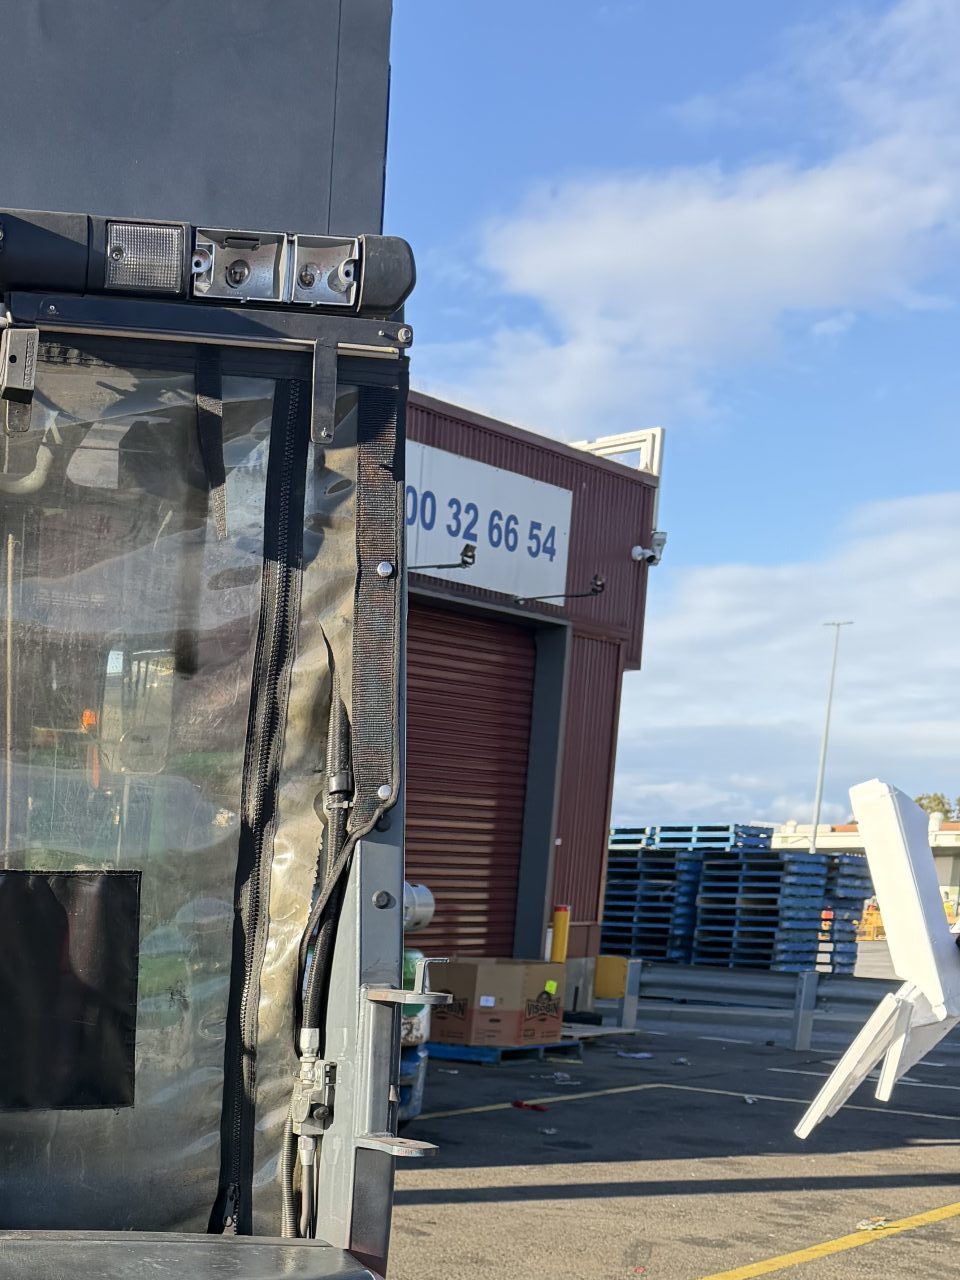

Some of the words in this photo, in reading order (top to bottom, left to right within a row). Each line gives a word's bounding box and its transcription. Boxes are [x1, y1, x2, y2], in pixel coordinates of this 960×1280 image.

[446, 498, 479, 542] 32
[488, 510, 519, 552] 66
[527, 521, 557, 562] 54
